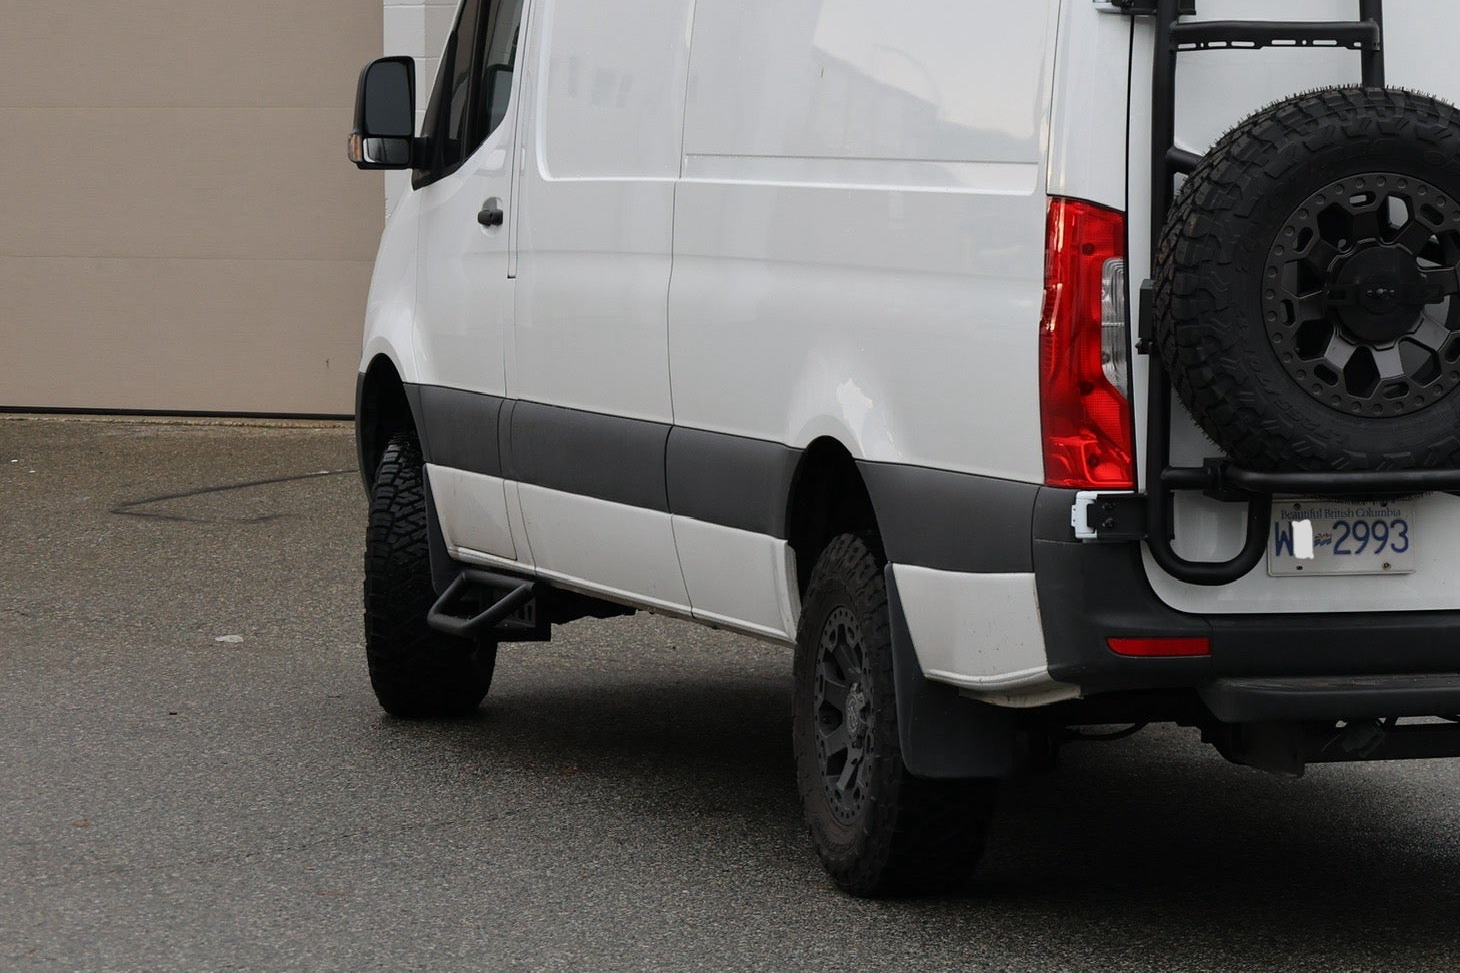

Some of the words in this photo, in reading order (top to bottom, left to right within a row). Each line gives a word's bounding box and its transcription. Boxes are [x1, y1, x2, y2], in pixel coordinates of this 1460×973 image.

[1281, 508, 1321, 520] Beautiful
[1325, 508, 1354, 518] British
[1356, 507, 1401, 518] Columbia
[1332, 519, 1408, 555] 2993
